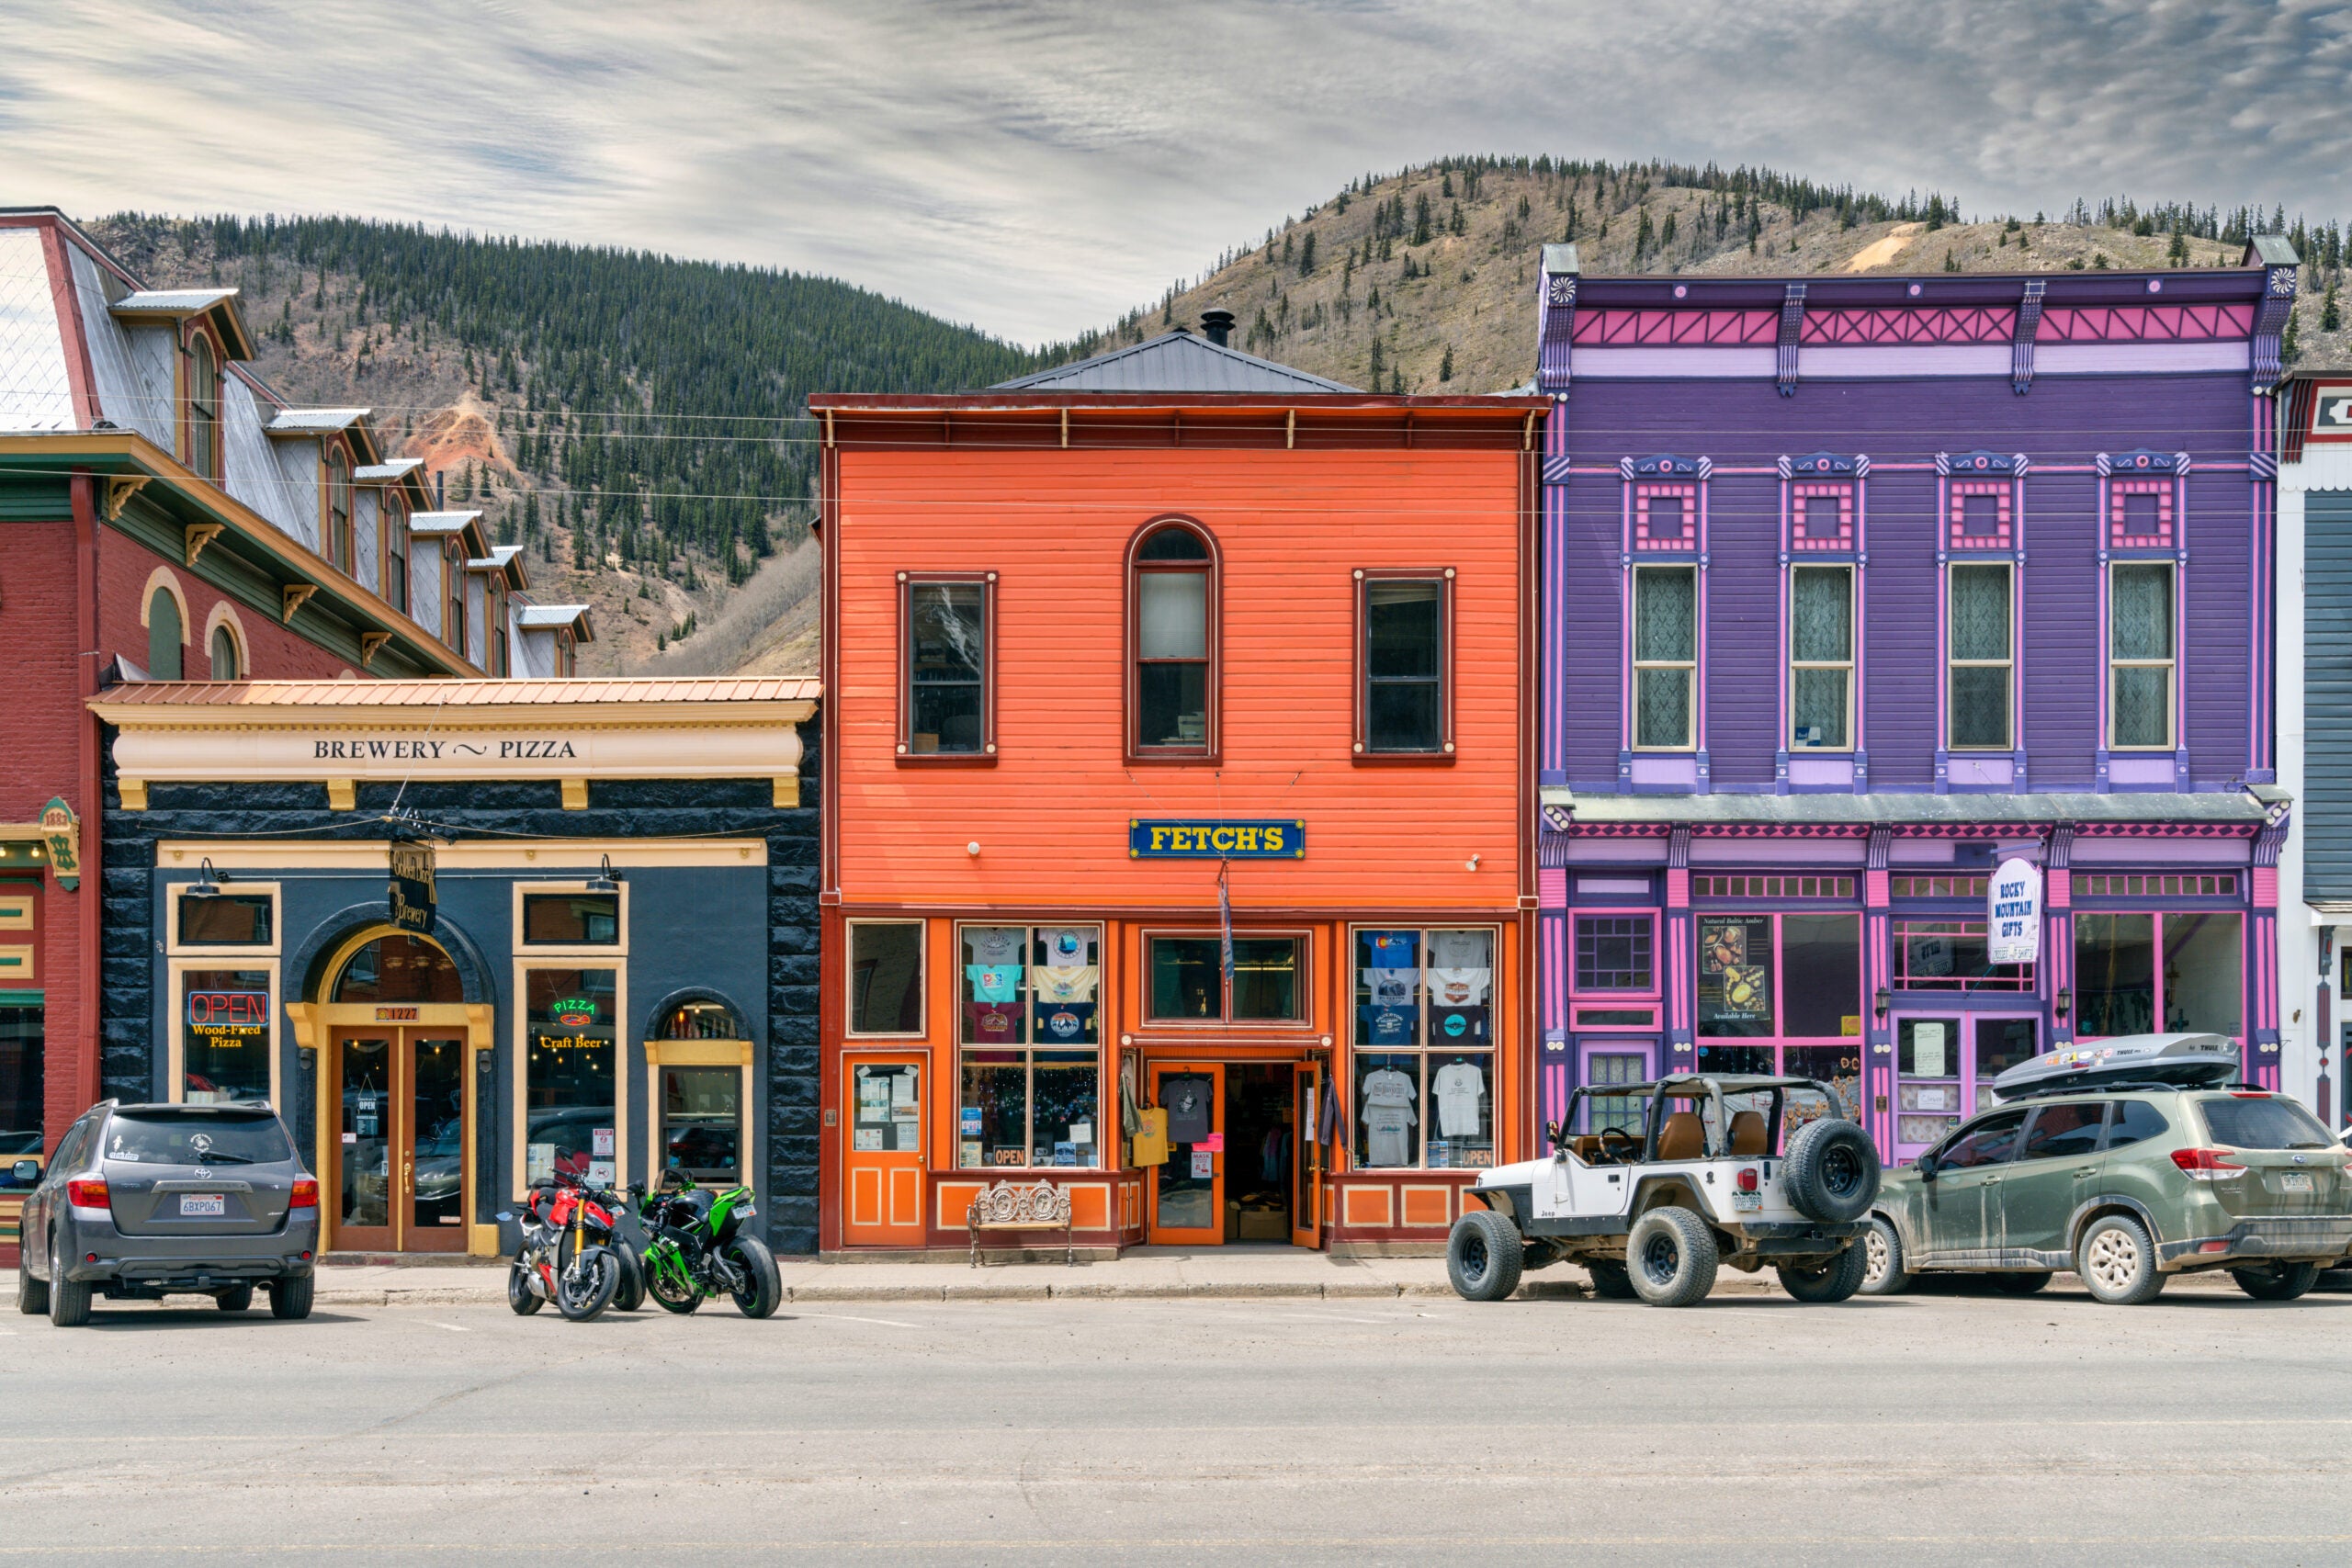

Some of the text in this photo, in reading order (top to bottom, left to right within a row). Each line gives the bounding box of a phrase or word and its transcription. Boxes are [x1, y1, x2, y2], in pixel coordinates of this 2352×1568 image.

[313, 740, 577, 759] BREWERY PIZZA
[1150, 827, 1283, 851] FETCH'S
[2000, 881, 2025, 898] ROCKY
[397, 893, 428, 928] Brewery
[1995, 900, 2032, 919] MOUNTAIN
[2002, 921, 2022, 937] GIFTS
[192, 995, 266, 1022] OPEN
[392, 1008, 417, 1020] 1227
[553, 999, 595, 1014] PIZZA
[192, 1024, 261, 1035] Wood-Fired
[209, 1036, 243, 1047] Pizza
[540, 1037, 602, 1048] Craft Beer
[358, 1101, 376, 1110] OPEN
[995, 1149, 1024, 1165] OPEN
[1463, 1150, 1491, 1165] OPEN
[184, 1201, 221, 1213] 6BXP067
